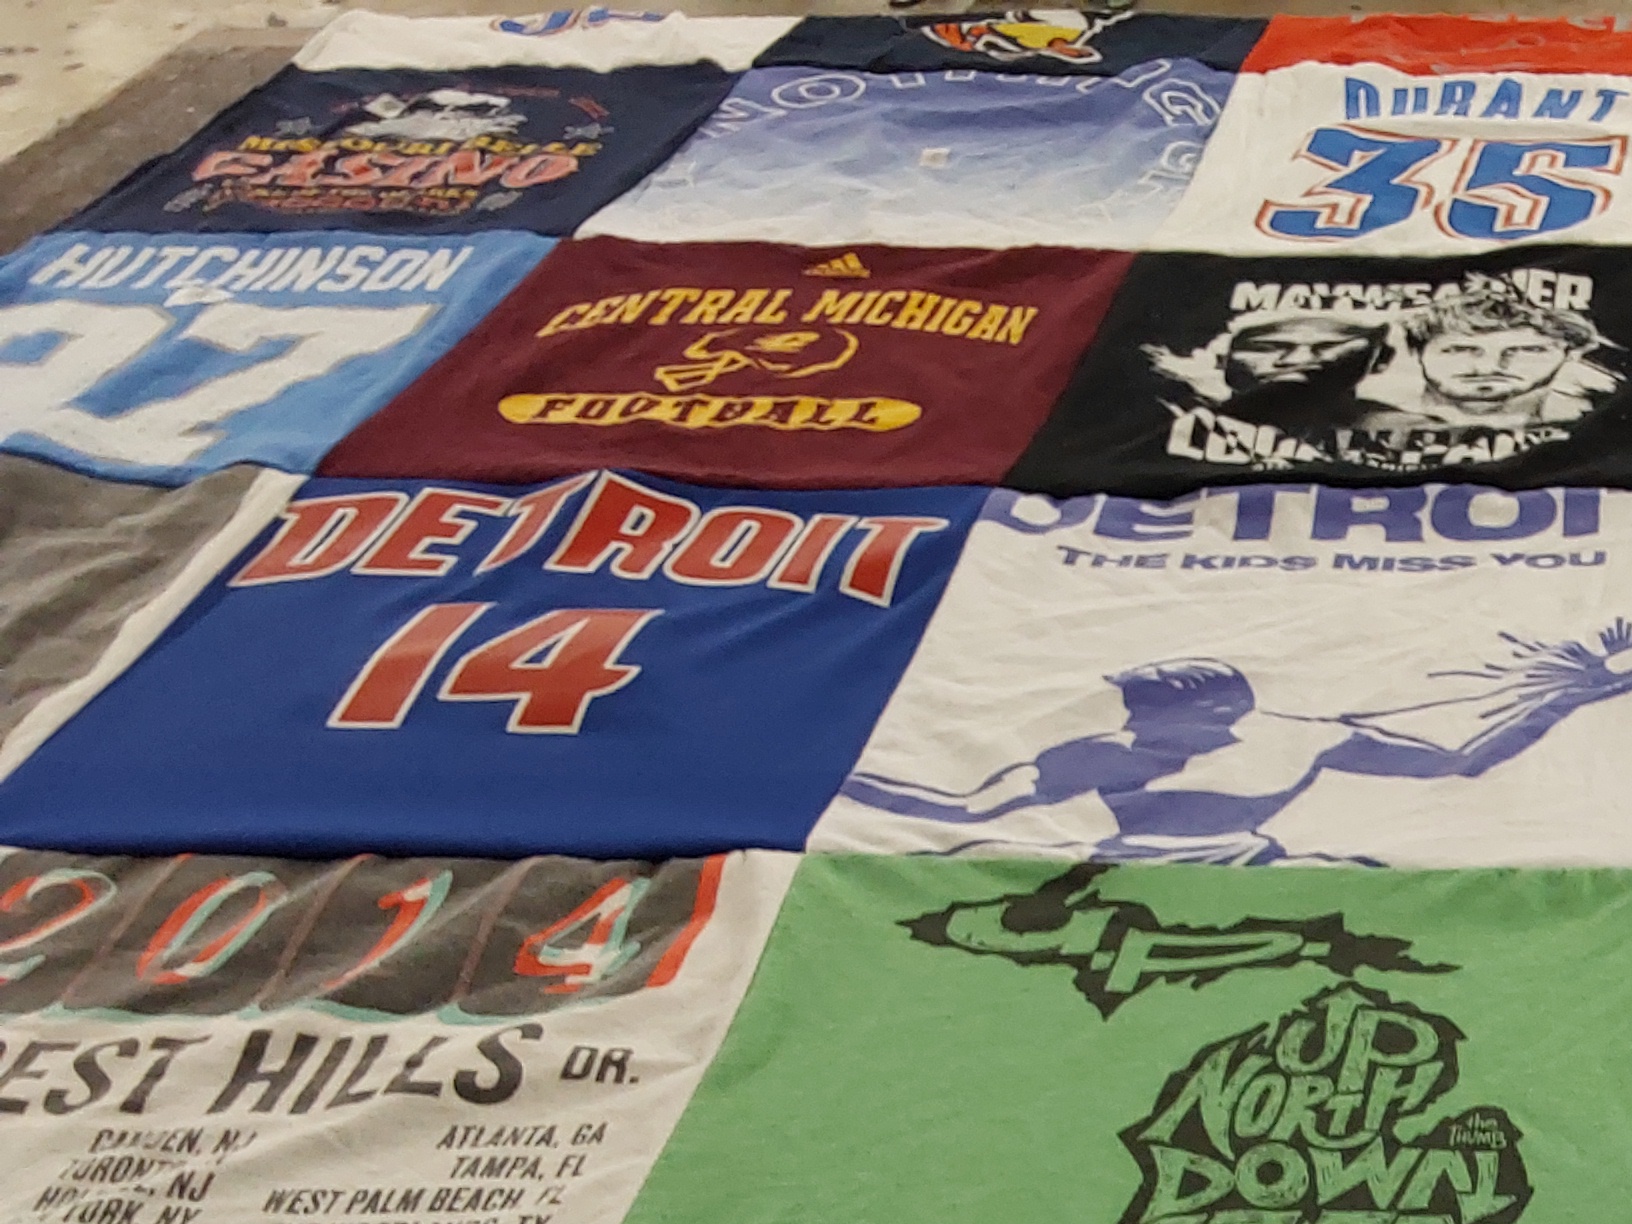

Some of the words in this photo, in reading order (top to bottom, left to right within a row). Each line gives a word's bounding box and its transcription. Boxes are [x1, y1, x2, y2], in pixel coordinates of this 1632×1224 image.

[1345, 77, 1630, 121] DURANT
[191, 150, 581, 189] CASINO
[1255, 122, 1630, 242] 35
[29, 243, 474, 292] HUTCHINSON
[536, 288, 793, 339] CENTRAL
[802, 290, 1039, 345] MICHIGAN
[226, 469, 950, 607] DETROIT
[1055, 545, 1168, 572] THE
[1181, 553, 1316, 572] KIDS
[1333, 552, 1477, 573] MISS
[1491, 550, 1607, 569] YOU
[326, 601, 666, 734] 14
[0, 868, 648, 994] 2014
[0, 1036, 213, 1115] EST
[205, 1022, 544, 1118] HILLS
[559, 1046, 642, 1085] DR.
[1137, 1041, 1445, 1162] NORTH
[437, 1123, 560, 1151] ATLANTA,
[571, 1122, 609, 1147] GA
[166, 1170, 217, 1203] NJ
[449, 1155, 545, 1182] TAMPA,
[556, 1153, 588, 1179] FL
[261, 1188, 347, 1215] WEST
[345, 1188, 428, 1215] PALM
